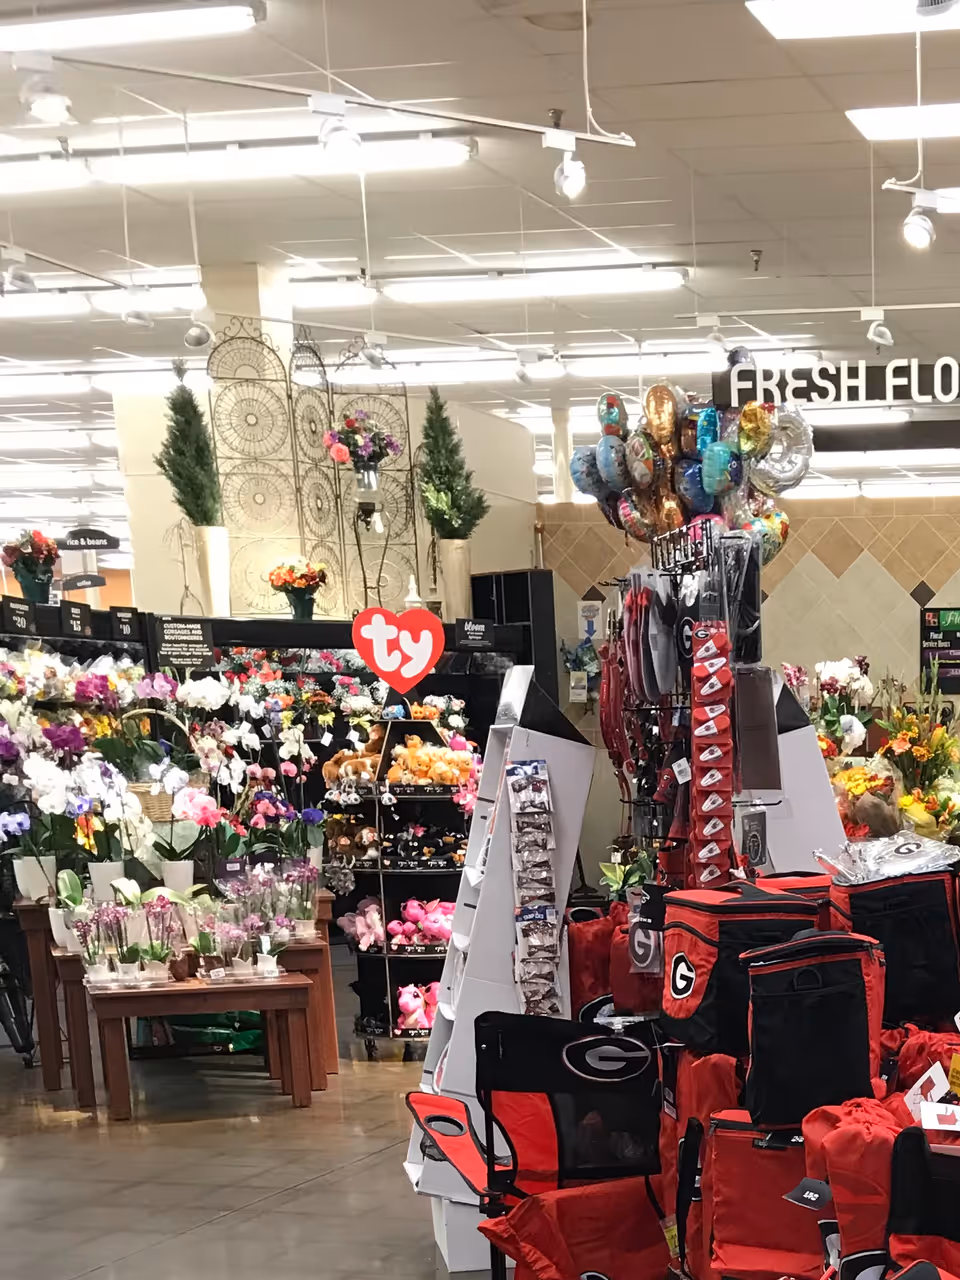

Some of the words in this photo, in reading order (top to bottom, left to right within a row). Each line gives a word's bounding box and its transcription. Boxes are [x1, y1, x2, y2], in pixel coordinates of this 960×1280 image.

[731, 359, 866, 407] FRESH
[80, 537, 86, 545] &
[360, 613, 433, 678] ty
